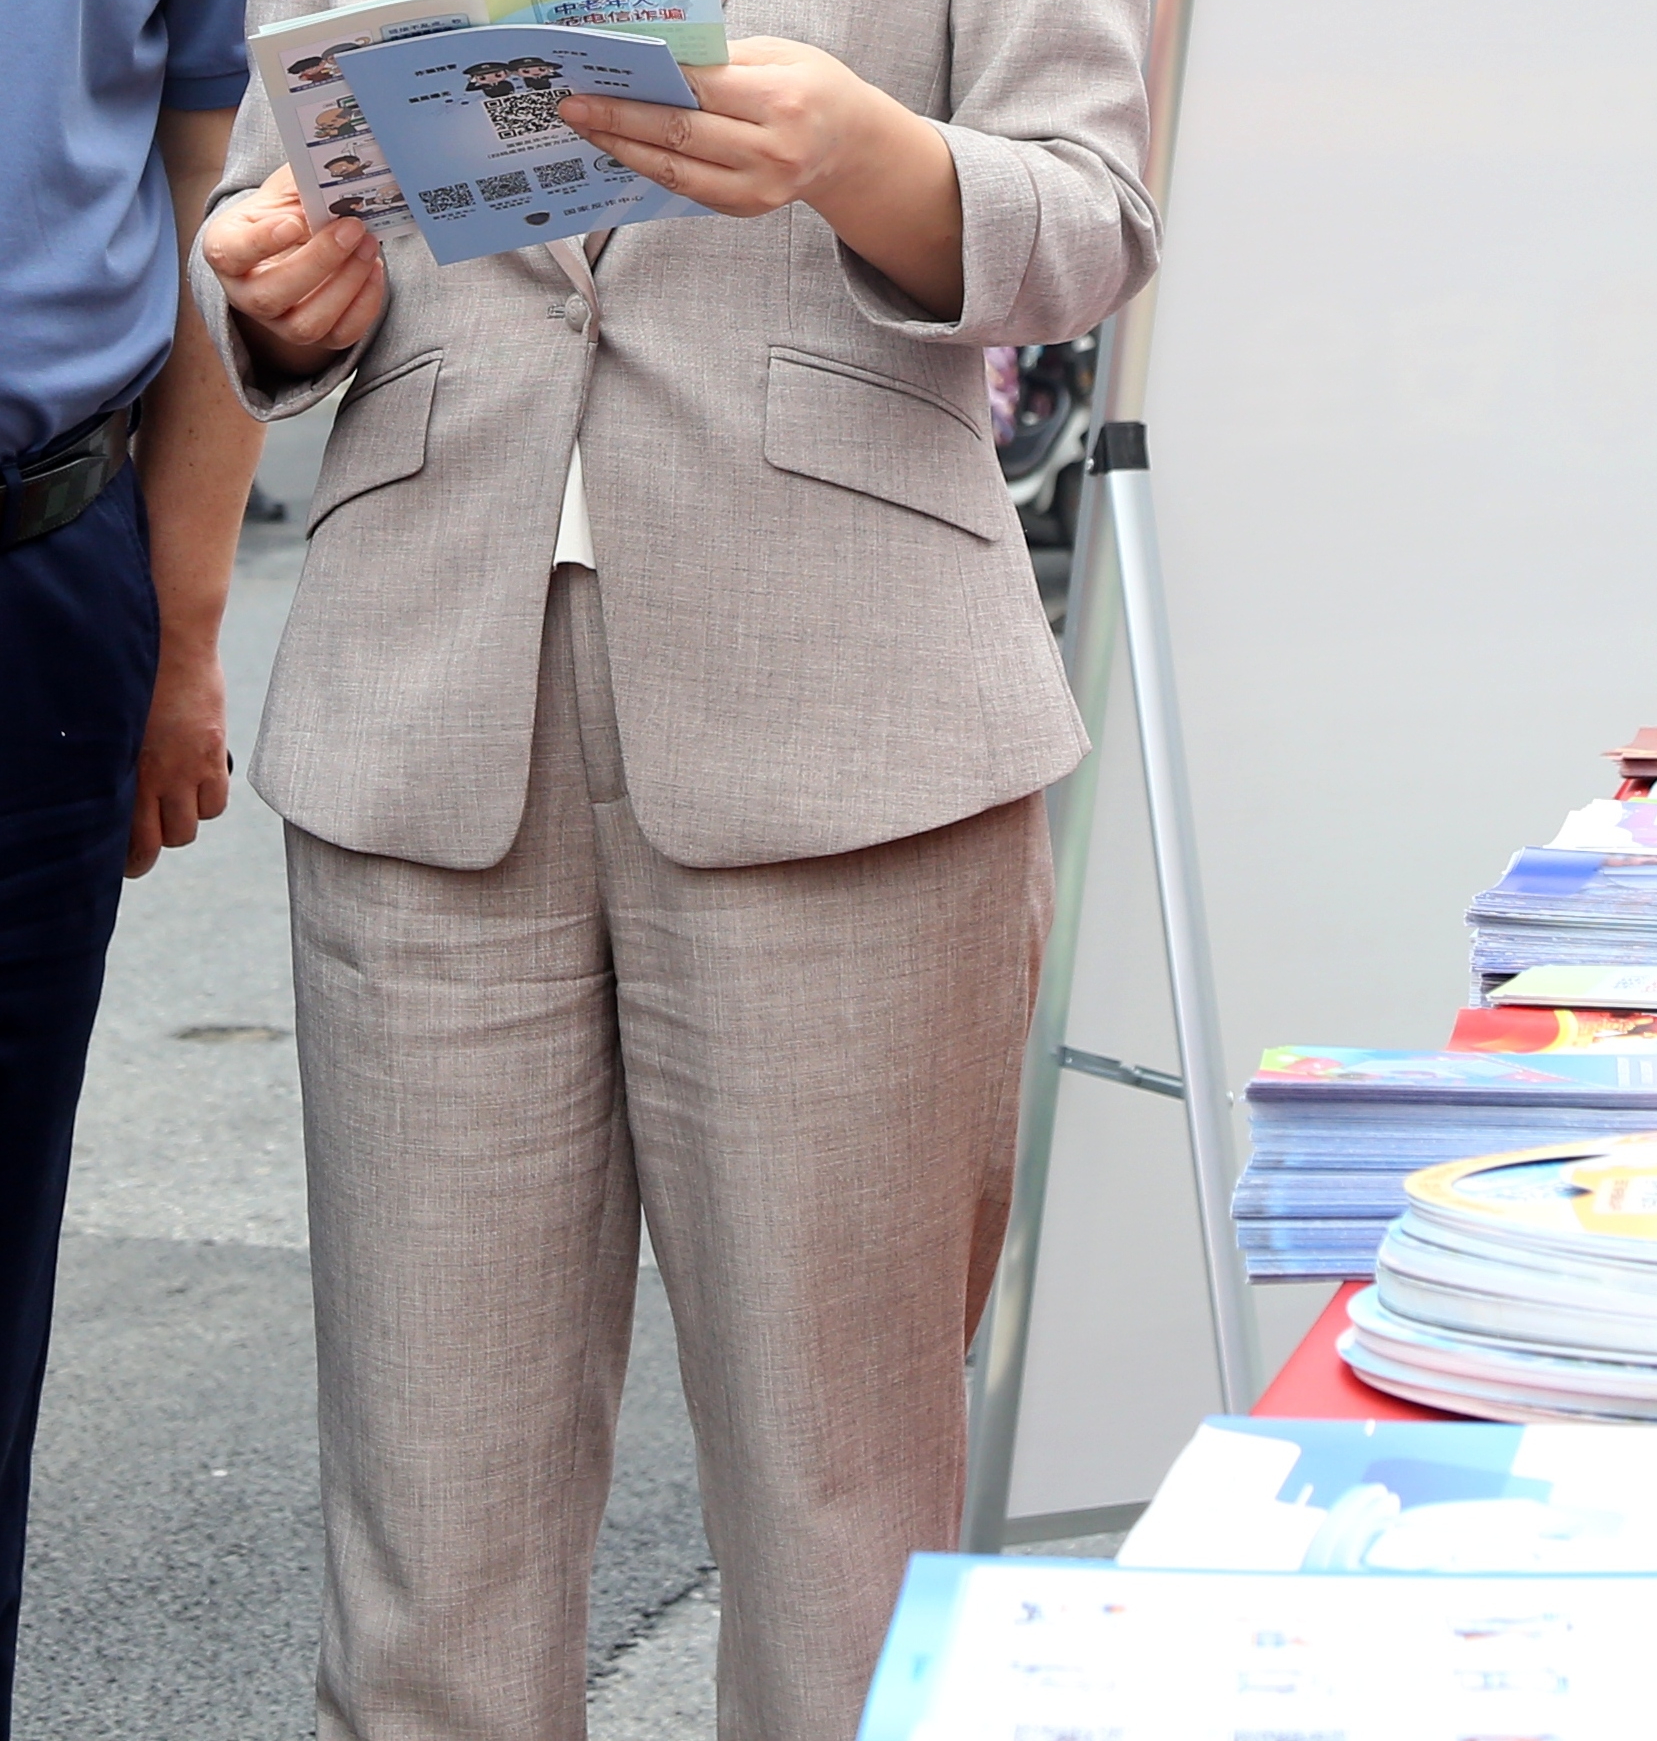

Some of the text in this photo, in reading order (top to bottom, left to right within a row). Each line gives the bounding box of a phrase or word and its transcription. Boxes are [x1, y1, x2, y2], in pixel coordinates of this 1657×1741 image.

[546, 7, 686, 26] 范电信诈骗
